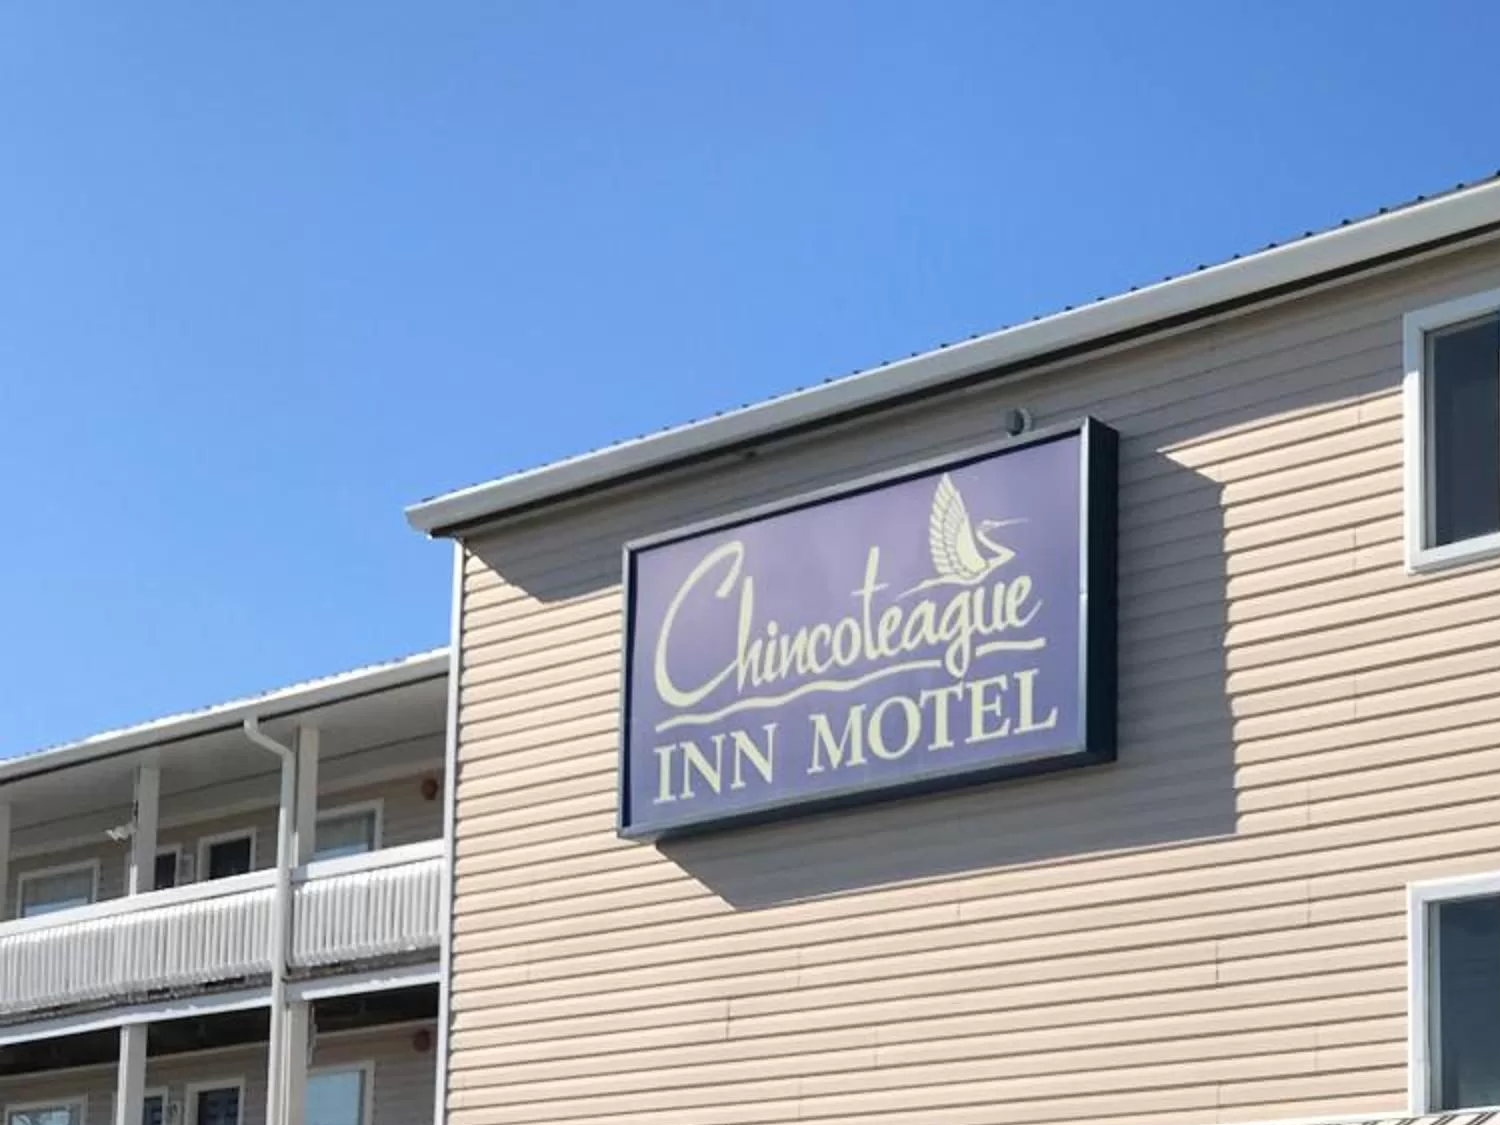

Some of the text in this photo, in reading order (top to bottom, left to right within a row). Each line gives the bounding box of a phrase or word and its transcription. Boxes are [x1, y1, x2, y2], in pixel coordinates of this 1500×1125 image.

[654, 540, 1043, 706] Chincoteague
[653, 668, 1058, 804] INN MOTEL
